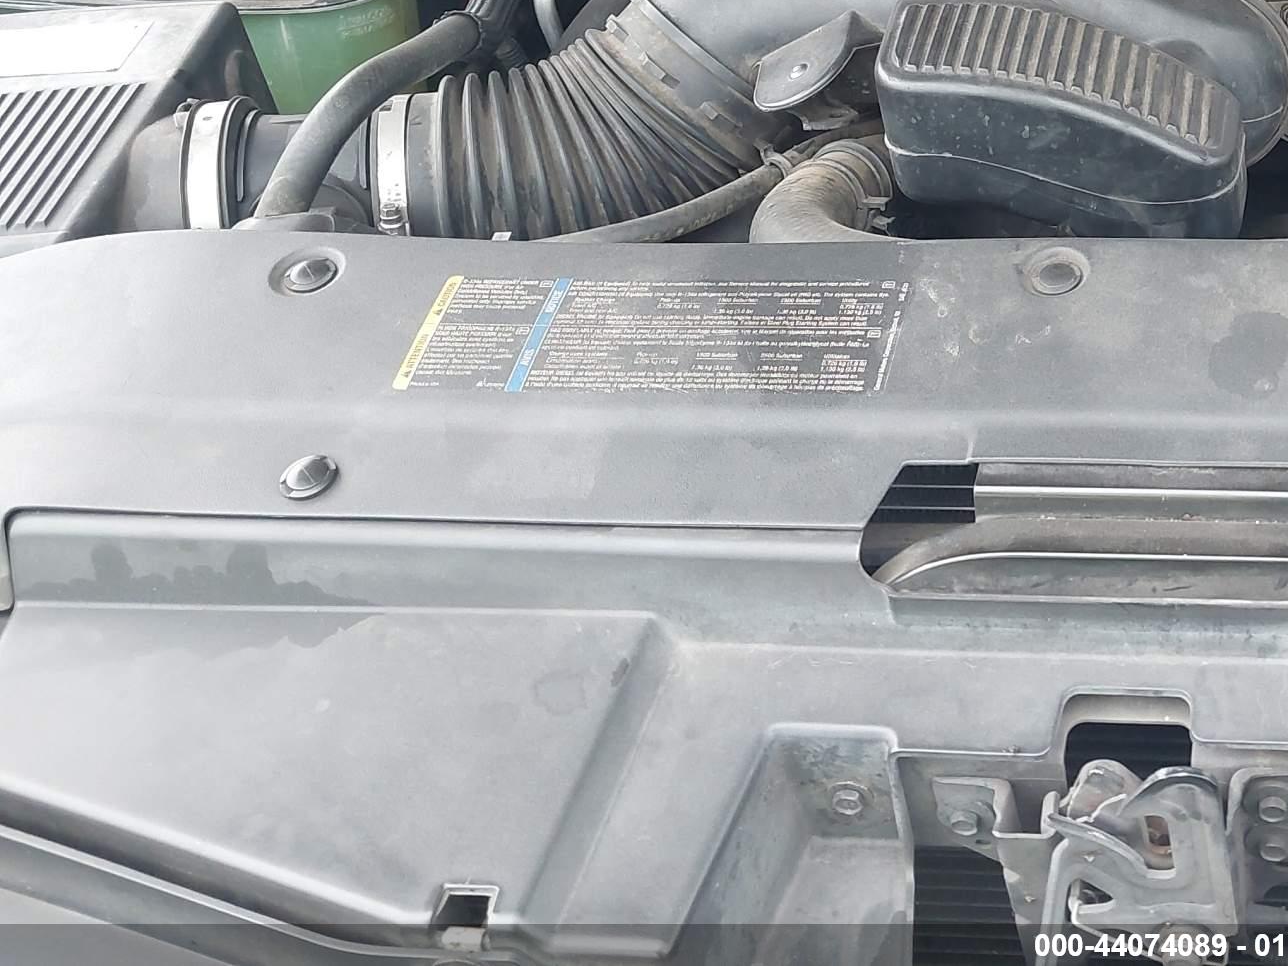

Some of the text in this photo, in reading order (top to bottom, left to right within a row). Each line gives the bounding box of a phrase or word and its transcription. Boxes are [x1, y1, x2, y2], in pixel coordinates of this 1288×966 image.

[438, 282, 457, 307] CAUTION
[545, 290, 564, 313] NOTICE
[406, 333, 429, 368] ATTENTION
[520, 348, 535, 367] AVIS
